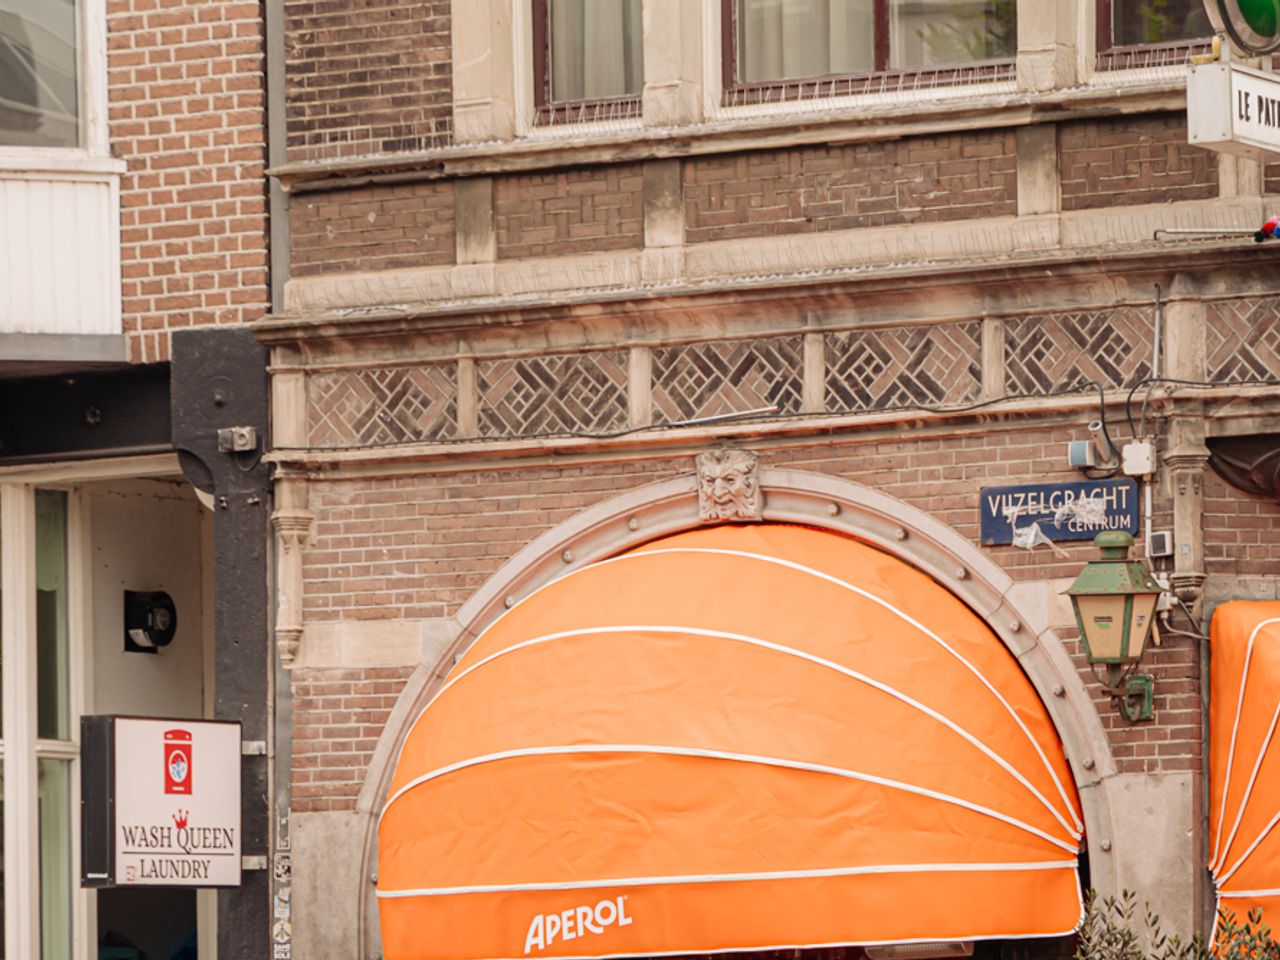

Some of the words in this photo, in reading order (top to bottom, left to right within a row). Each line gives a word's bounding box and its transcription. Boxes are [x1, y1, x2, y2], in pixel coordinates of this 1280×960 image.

[1238, 89, 1251, 122] LE
[1067, 514, 1131, 533] CENTRUM
[121, 825, 172, 849] WASH
[176, 827, 235, 854] QUEEN
[139, 859, 211, 879] LAUNDRY
[523, 895, 633, 955] APEROL
